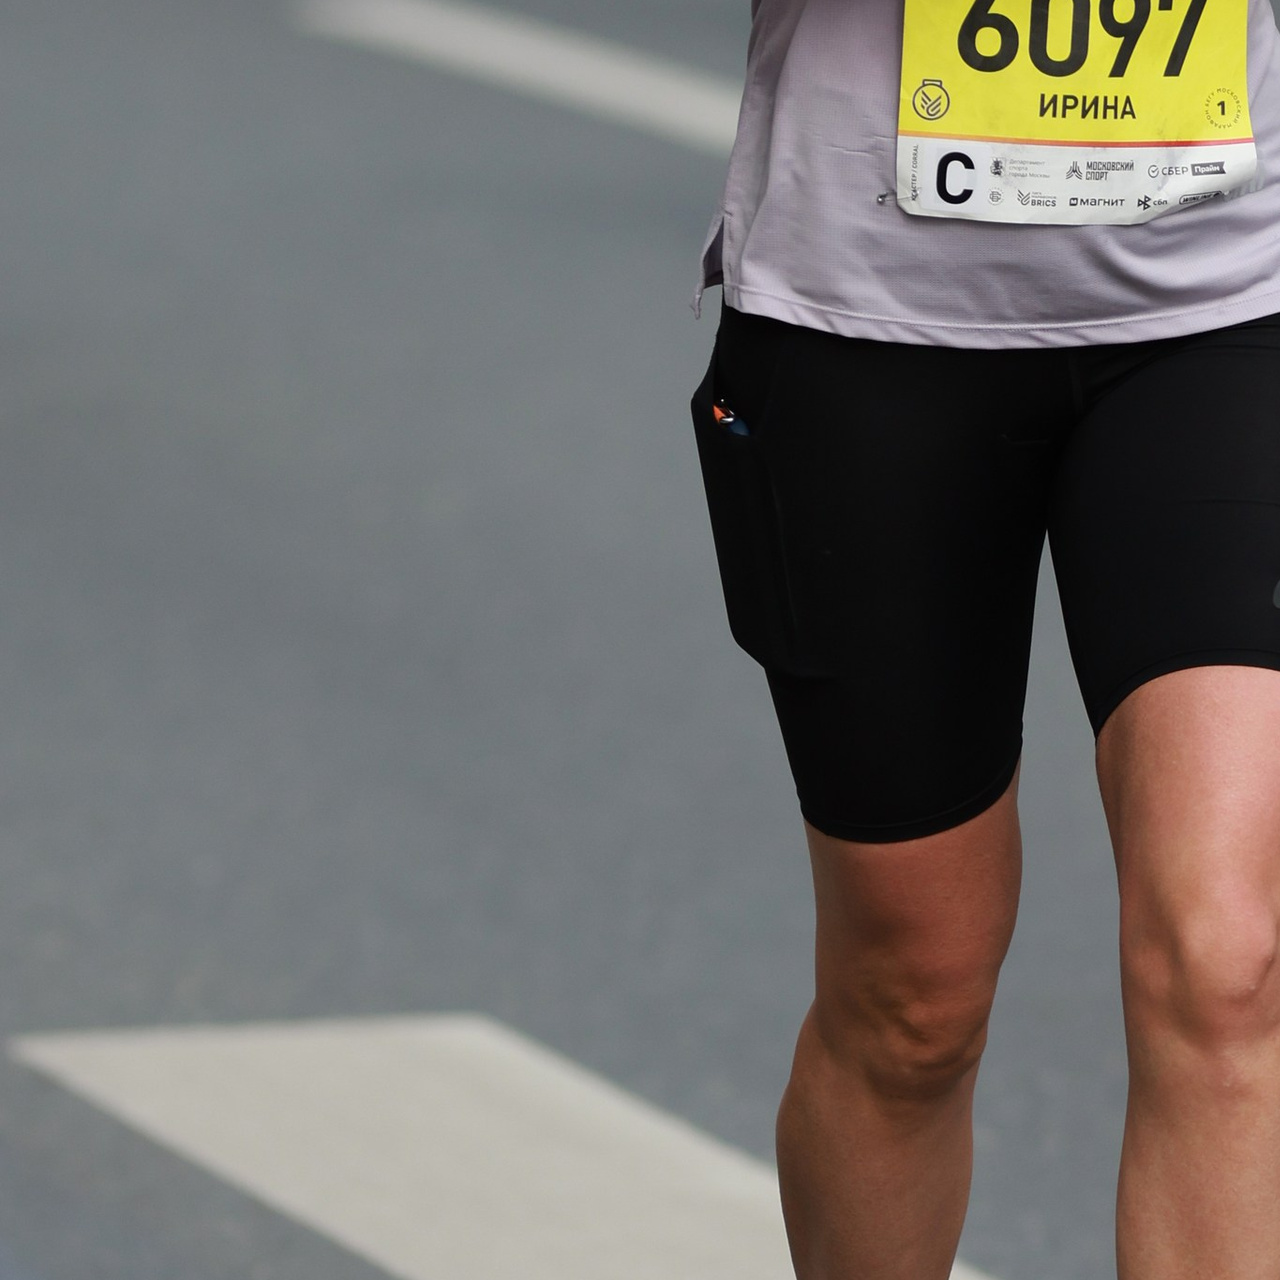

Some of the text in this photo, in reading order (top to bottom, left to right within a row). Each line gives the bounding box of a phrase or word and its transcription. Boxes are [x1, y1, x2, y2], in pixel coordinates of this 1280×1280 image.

[1039, 93, 1137, 120] ИРИНА
[1217, 100, 1225, 116] 1
[1085, 159, 1135, 171] МОСКОВСКИЙ
[1085, 171, 1109, 181] СПОРТ
[1161, 167, 1189, 176] СБЕР
[1031, 199, 1057, 207] BRICS
[1153, 198, 1168, 206] сбп
